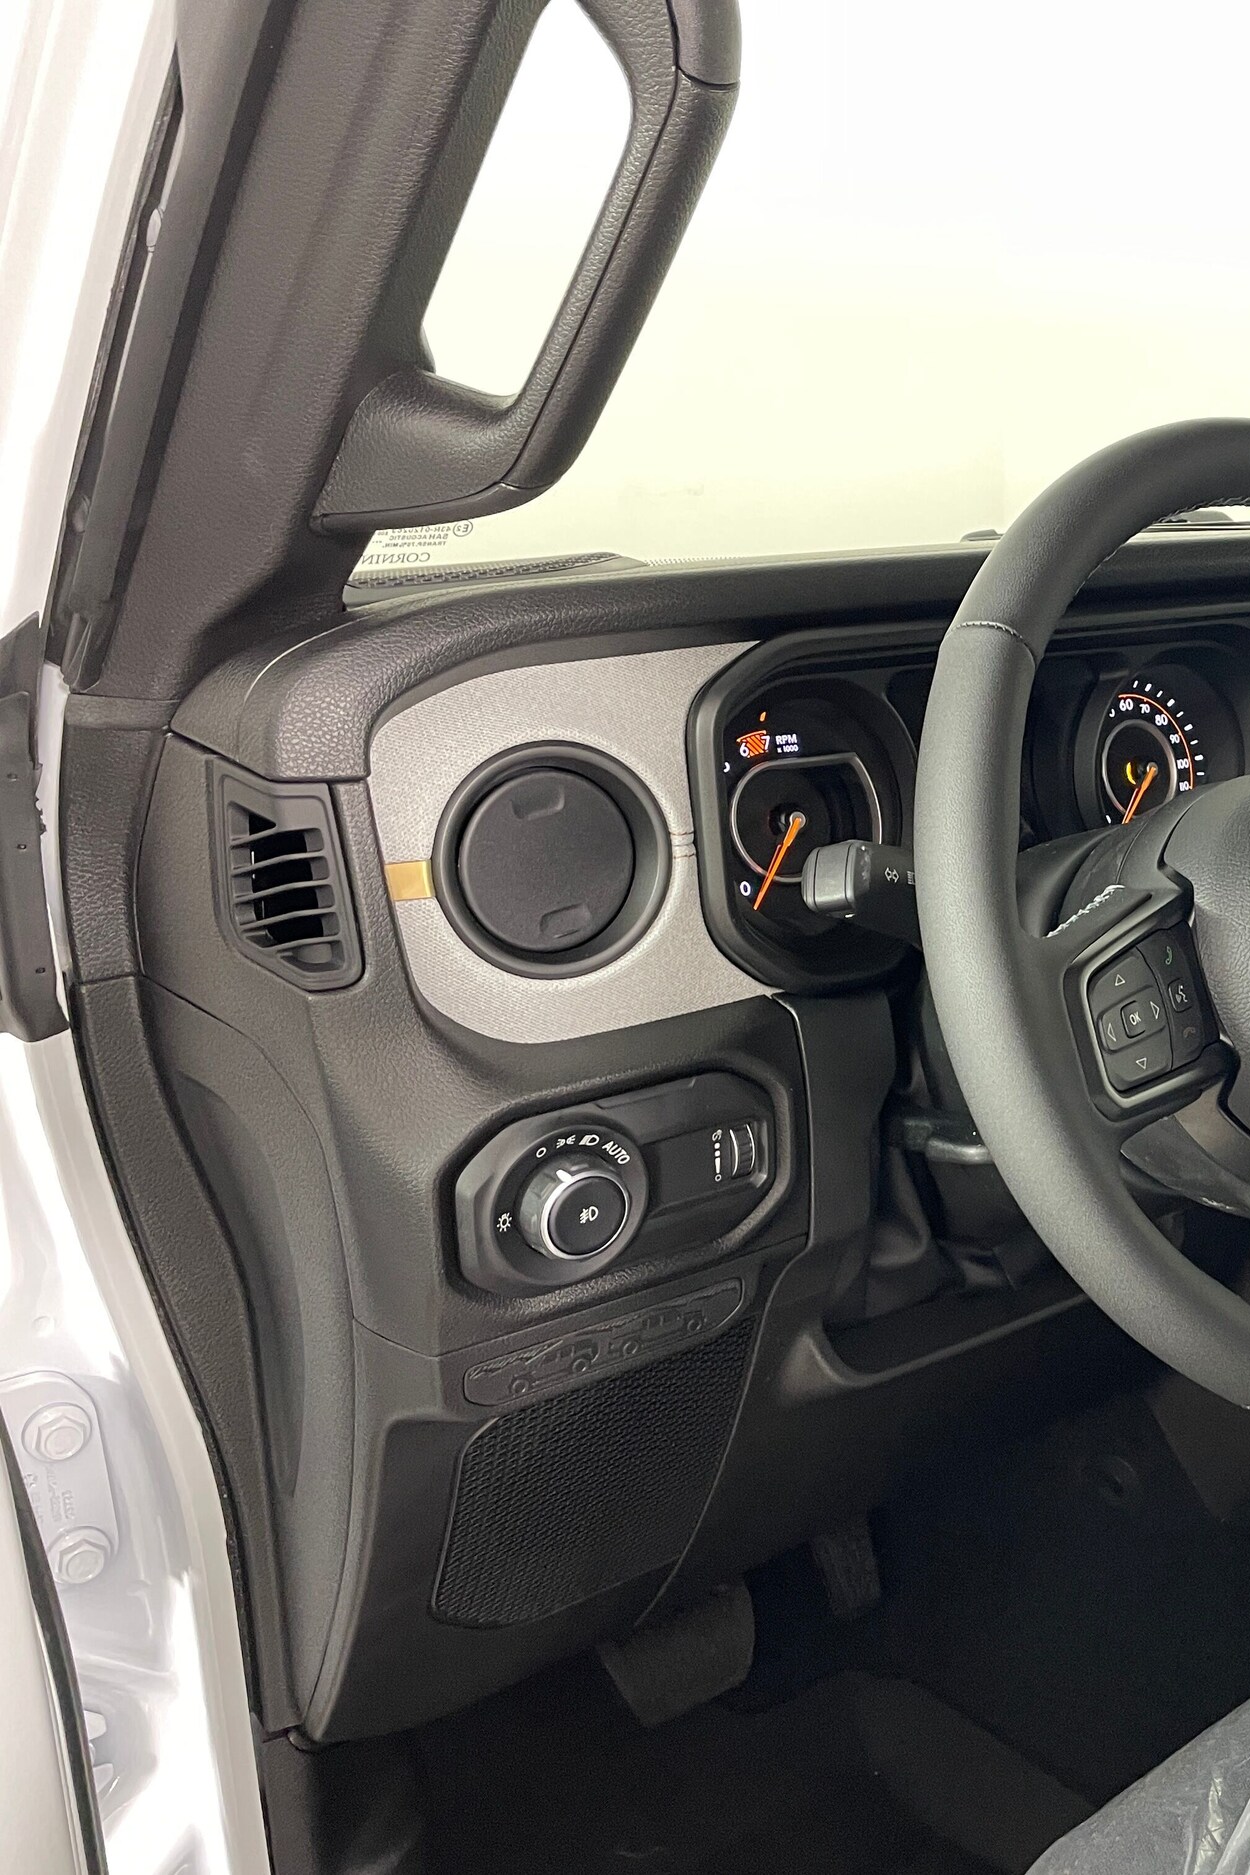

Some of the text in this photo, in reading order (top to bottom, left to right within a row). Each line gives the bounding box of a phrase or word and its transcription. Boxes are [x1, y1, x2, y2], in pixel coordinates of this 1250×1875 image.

[1119, 698, 1134, 712] 60
[1139, 703, 1151, 714] 70
[1155, 713, 1169, 726] 80
[760, 735, 770, 750] 7
[775, 733, 798, 745] RPM
[1169, 733, 1181, 744] 90
[740, 742, 750, 757] 6
[782, 744, 799, 753] 1000
[1176, 758, 1190, 770] 100
[1179, 780, 1191, 792] 110
[740, 880, 751, 896] 0
[1129, 1011, 1142, 1025] OK
[601, 1140, 631, 1165] AUTO
